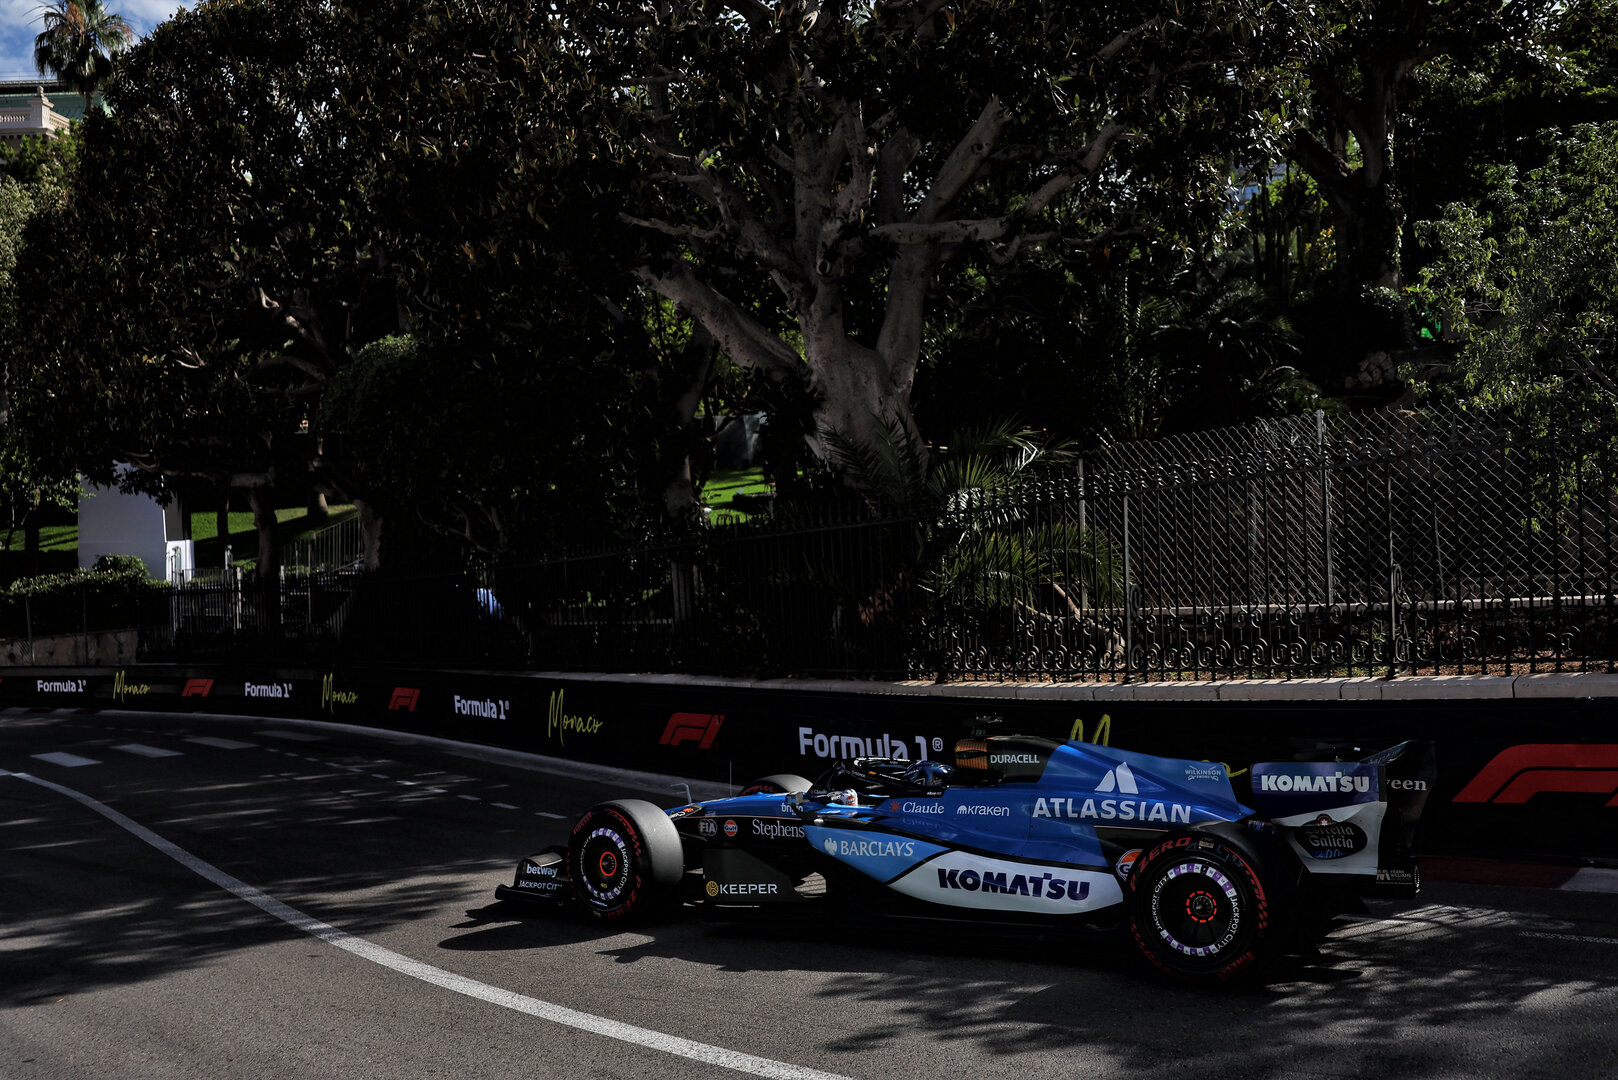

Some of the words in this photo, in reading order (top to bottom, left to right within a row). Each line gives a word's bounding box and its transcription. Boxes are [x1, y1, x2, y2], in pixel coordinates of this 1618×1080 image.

[37, 680, 76, 693] Formula
[113, 670, 151, 704] Monaco
[181, 678, 215, 697] F1
[244, 682, 282, 698] Formula
[321, 672, 359, 715] Monaco
[387, 686, 421, 712] F1
[453, 694, 498, 719] Formula
[548, 688, 603, 747] Monaco
[658, 712, 726, 749] F1
[798, 726, 909, 760] Formula
[990, 753, 1040, 764] DURACELL
[1261, 771, 1370, 793] KOMATSU
[1387, 779, 1428, 791] een
[1451, 743, 1618, 807] F
[902, 801, 945, 814] Claude
[1032, 797, 1191, 824] ATLASSIAN
[752, 818, 806, 839] Stephens
[840, 840, 915, 857] BARCLAYS
[1308, 834, 1355, 849] Galicia
[1138, 836, 1193, 873] ZERO
[526, 863, 558, 878] betway
[518, 880, 546, 890] JACKPOT
[719, 883, 778, 895] KEEPER
[937, 868, 1090, 901] KOMATSU
[1230, 897, 1240, 934] JACKPOT
[1217, 934, 1234, 950] CITY
